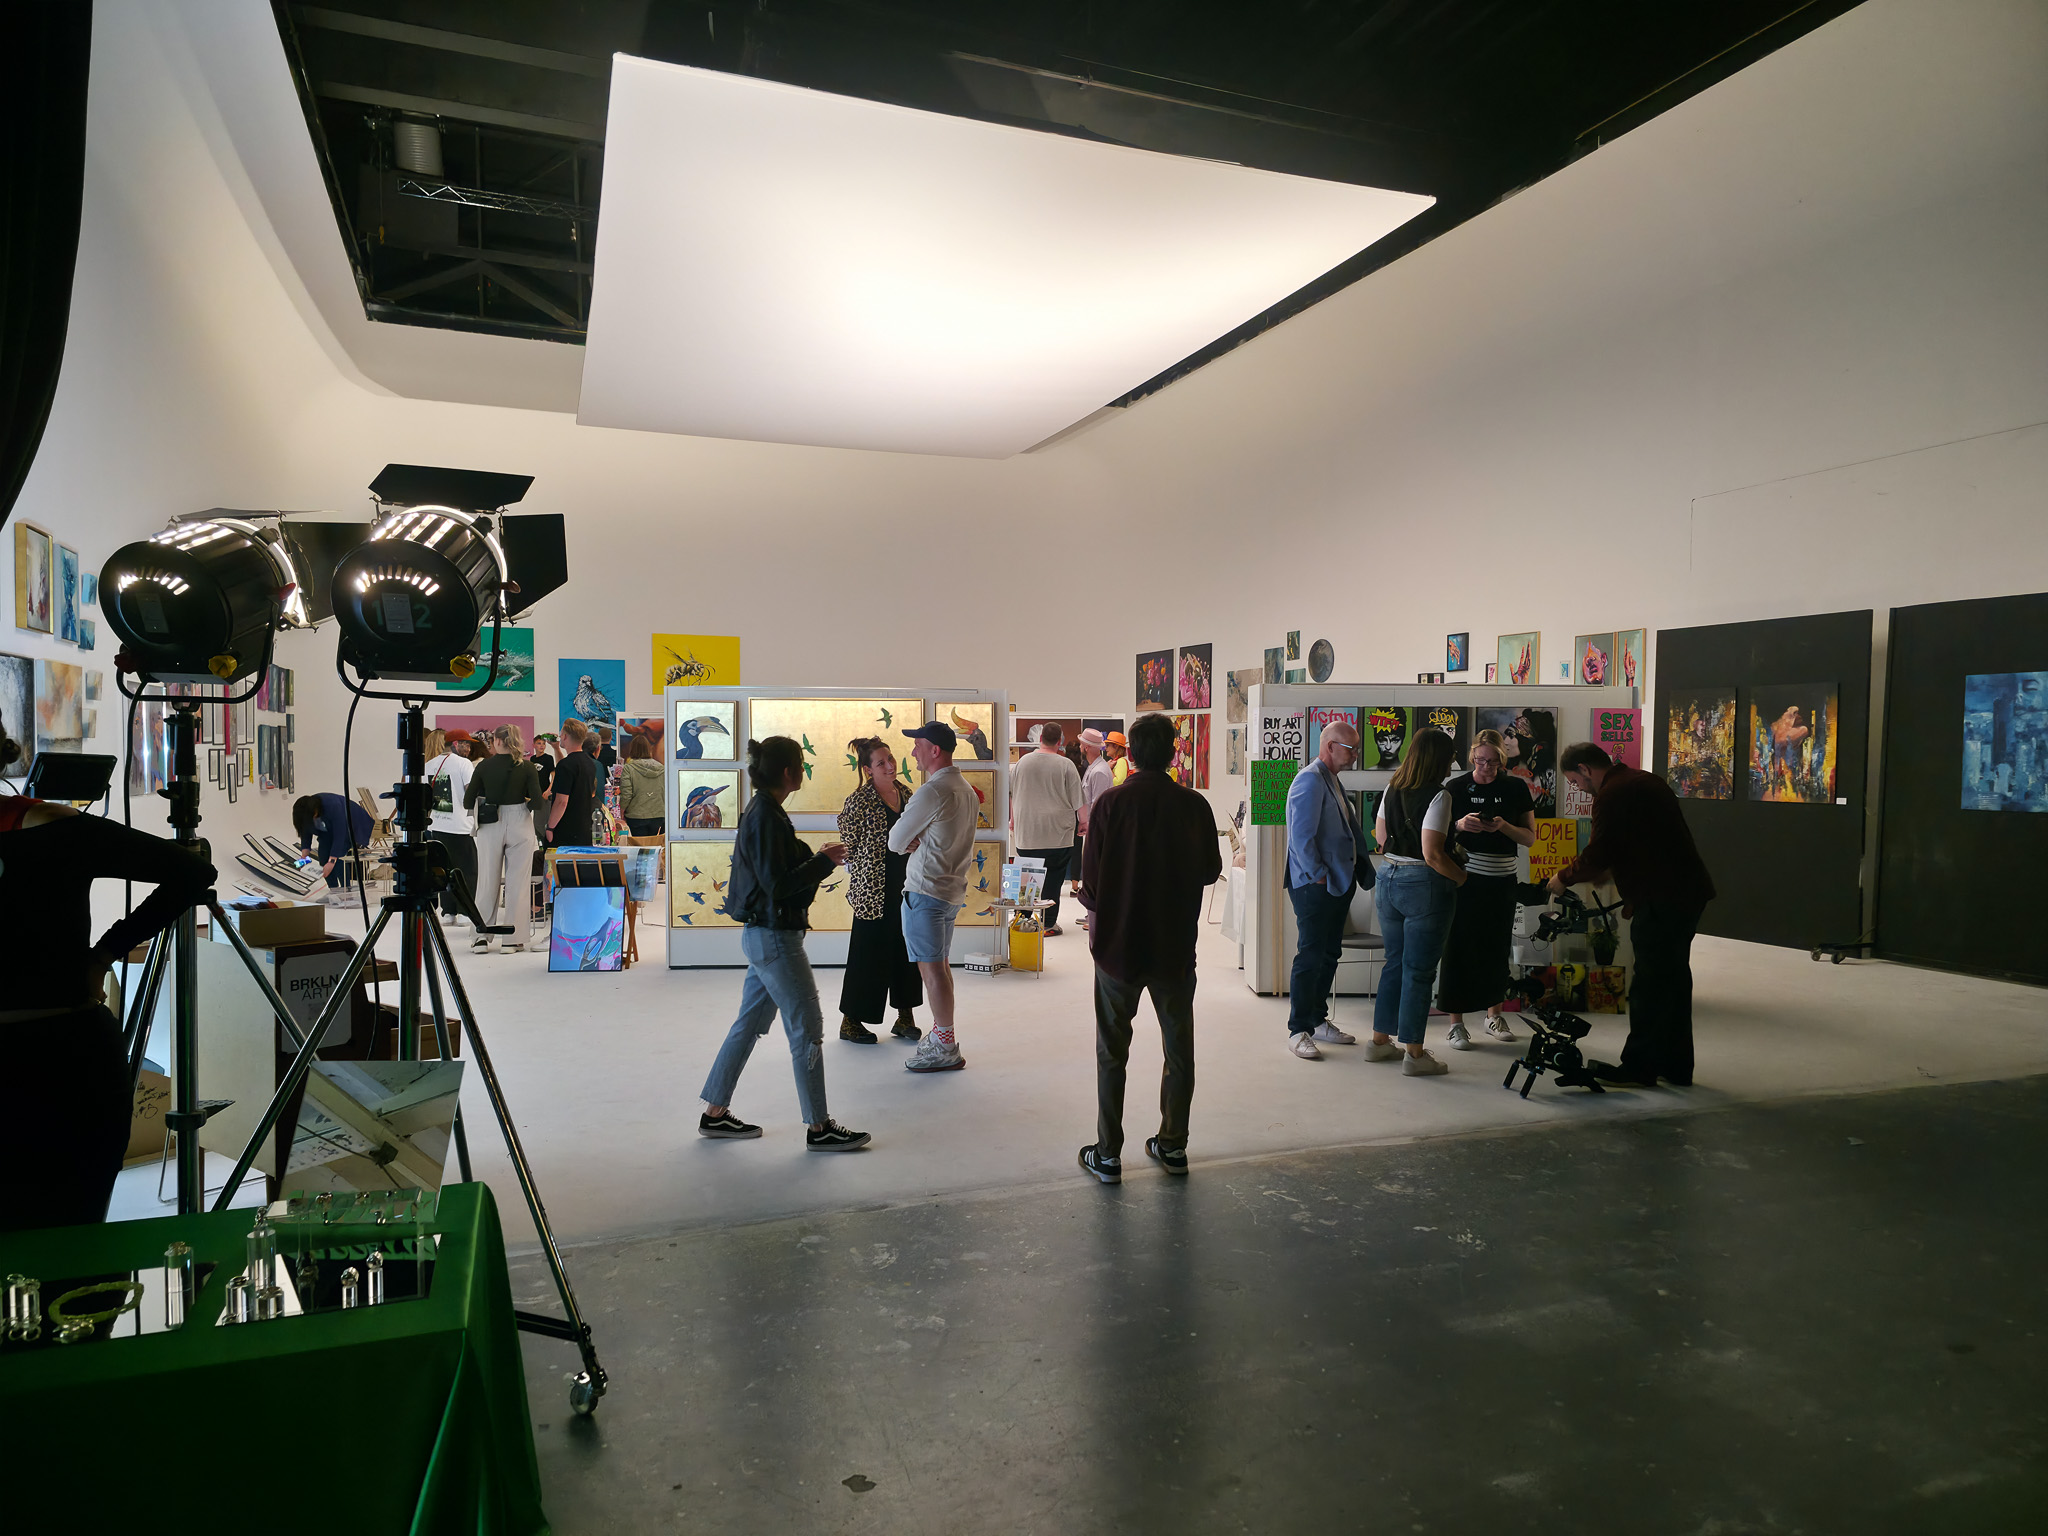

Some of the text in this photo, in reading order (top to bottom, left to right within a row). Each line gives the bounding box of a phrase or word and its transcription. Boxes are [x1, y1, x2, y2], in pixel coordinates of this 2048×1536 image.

[1263, 716, 1304, 730] BUY ART
[1600, 712, 1634, 731] SEX
[1263, 731, 1302, 745] OR GO
[1600, 731, 1634, 742] SELLS
[1263, 746, 1302, 760] HOME
[1253, 762, 1269, 771] BUY
[1269, 762, 1280, 770] MY
[1281, 761, 1297, 770] ART
[1252, 771, 1297, 780] AND BECOME
[1252, 780, 1291, 791] THE MOS
[1254, 791, 1288, 801] FEMINIS
[1566, 792, 1577, 803] AT
[1252, 802, 1281, 811] PERSON
[1565, 802, 1575, 816] 2
[1252, 812, 1286, 823] THE ROO
[1546, 842, 1557, 854] IS
[1529, 855, 1576, 866] WHERE MY
[1535, 867, 1557, 879] ART
[290, 974, 339, 992] BRKLN
[301, 986, 331, 1001] ART
